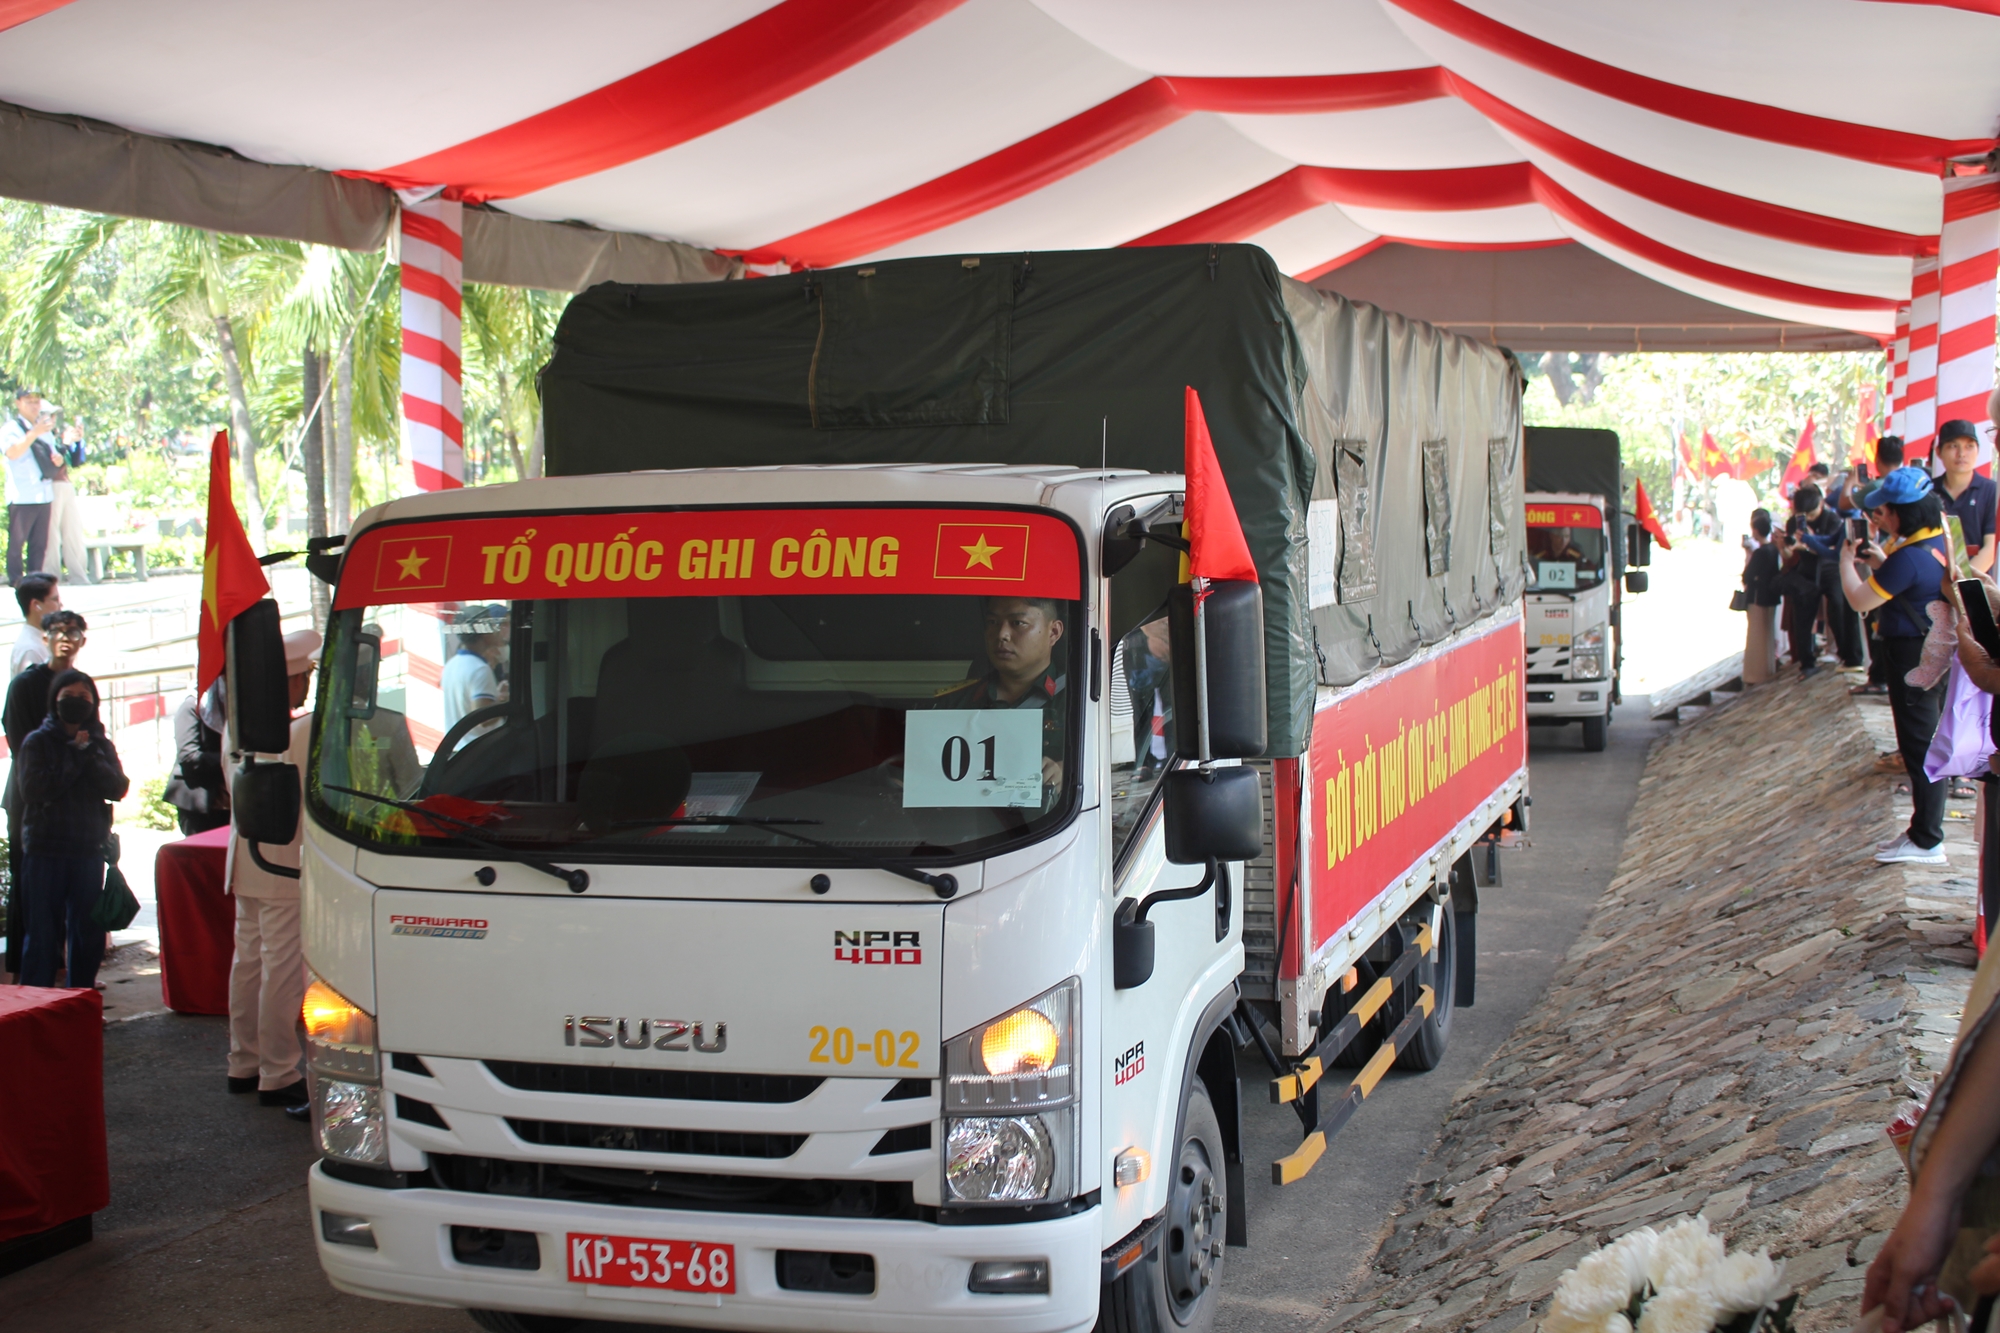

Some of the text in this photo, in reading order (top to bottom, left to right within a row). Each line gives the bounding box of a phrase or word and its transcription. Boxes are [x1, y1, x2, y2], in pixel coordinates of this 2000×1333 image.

[1526, 509, 1556, 524] ÔNG
[481, 527, 900, 587] TỔ QUỐC GHI CÔNG
[1548, 569, 1566, 582] 02
[1540, 633, 1571, 645] 20-02
[941, 735, 997, 782] 01
[1326, 748, 1352, 871] ĐỜI
[1354, 733, 1378, 849] ĐỜI
[1379, 717, 1406, 829] NHỚ
[1408, 718, 1425, 807] ƠN
[1426, 698, 1447, 794] CÁC
[1449, 698, 1468, 778] ANH
[1468, 676, 1491, 762] HÙNG
[1492, 663, 1507, 754] LIỆT
[390, 915, 488, 928] FORWARD
[834, 930, 921, 947] NPR
[834, 948, 922, 965] 400
[564, 1014, 728, 1053] ISUZU
[808, 1024, 920, 1069] 20-02
[1114, 1039, 1144, 1073] NPR
[1114, 1055, 1145, 1087] 400
[572, 1238, 729, 1288] KP-53-68
